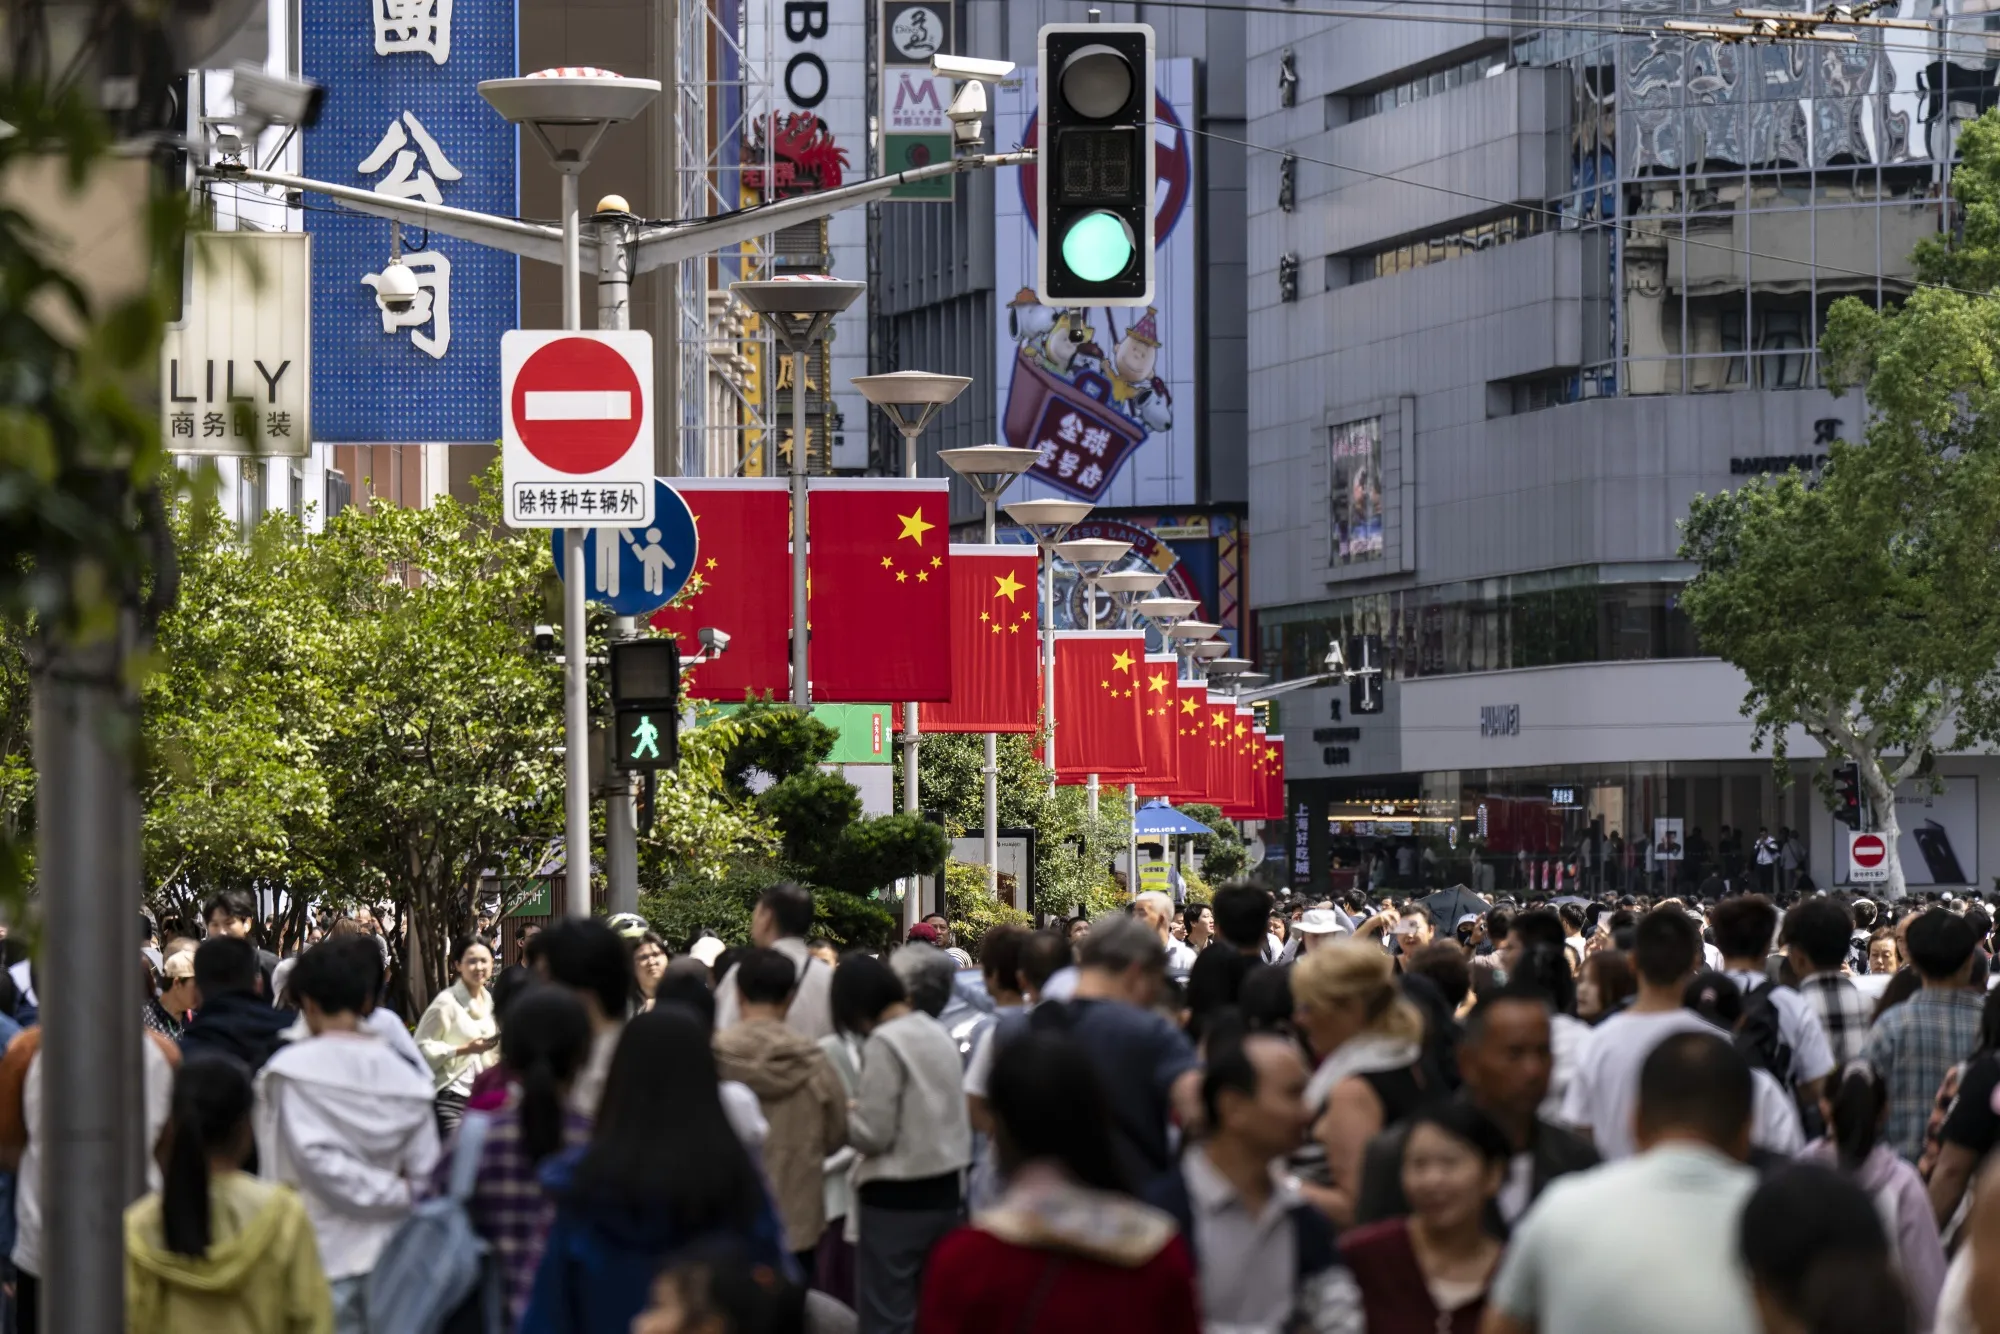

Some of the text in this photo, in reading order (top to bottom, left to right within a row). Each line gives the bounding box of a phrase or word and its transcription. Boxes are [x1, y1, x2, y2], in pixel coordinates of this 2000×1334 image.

[170, 359, 291, 403] LILY
[1057, 412, 1112, 457] 全球
[519, 489, 638, 515] 除特种车辆外
